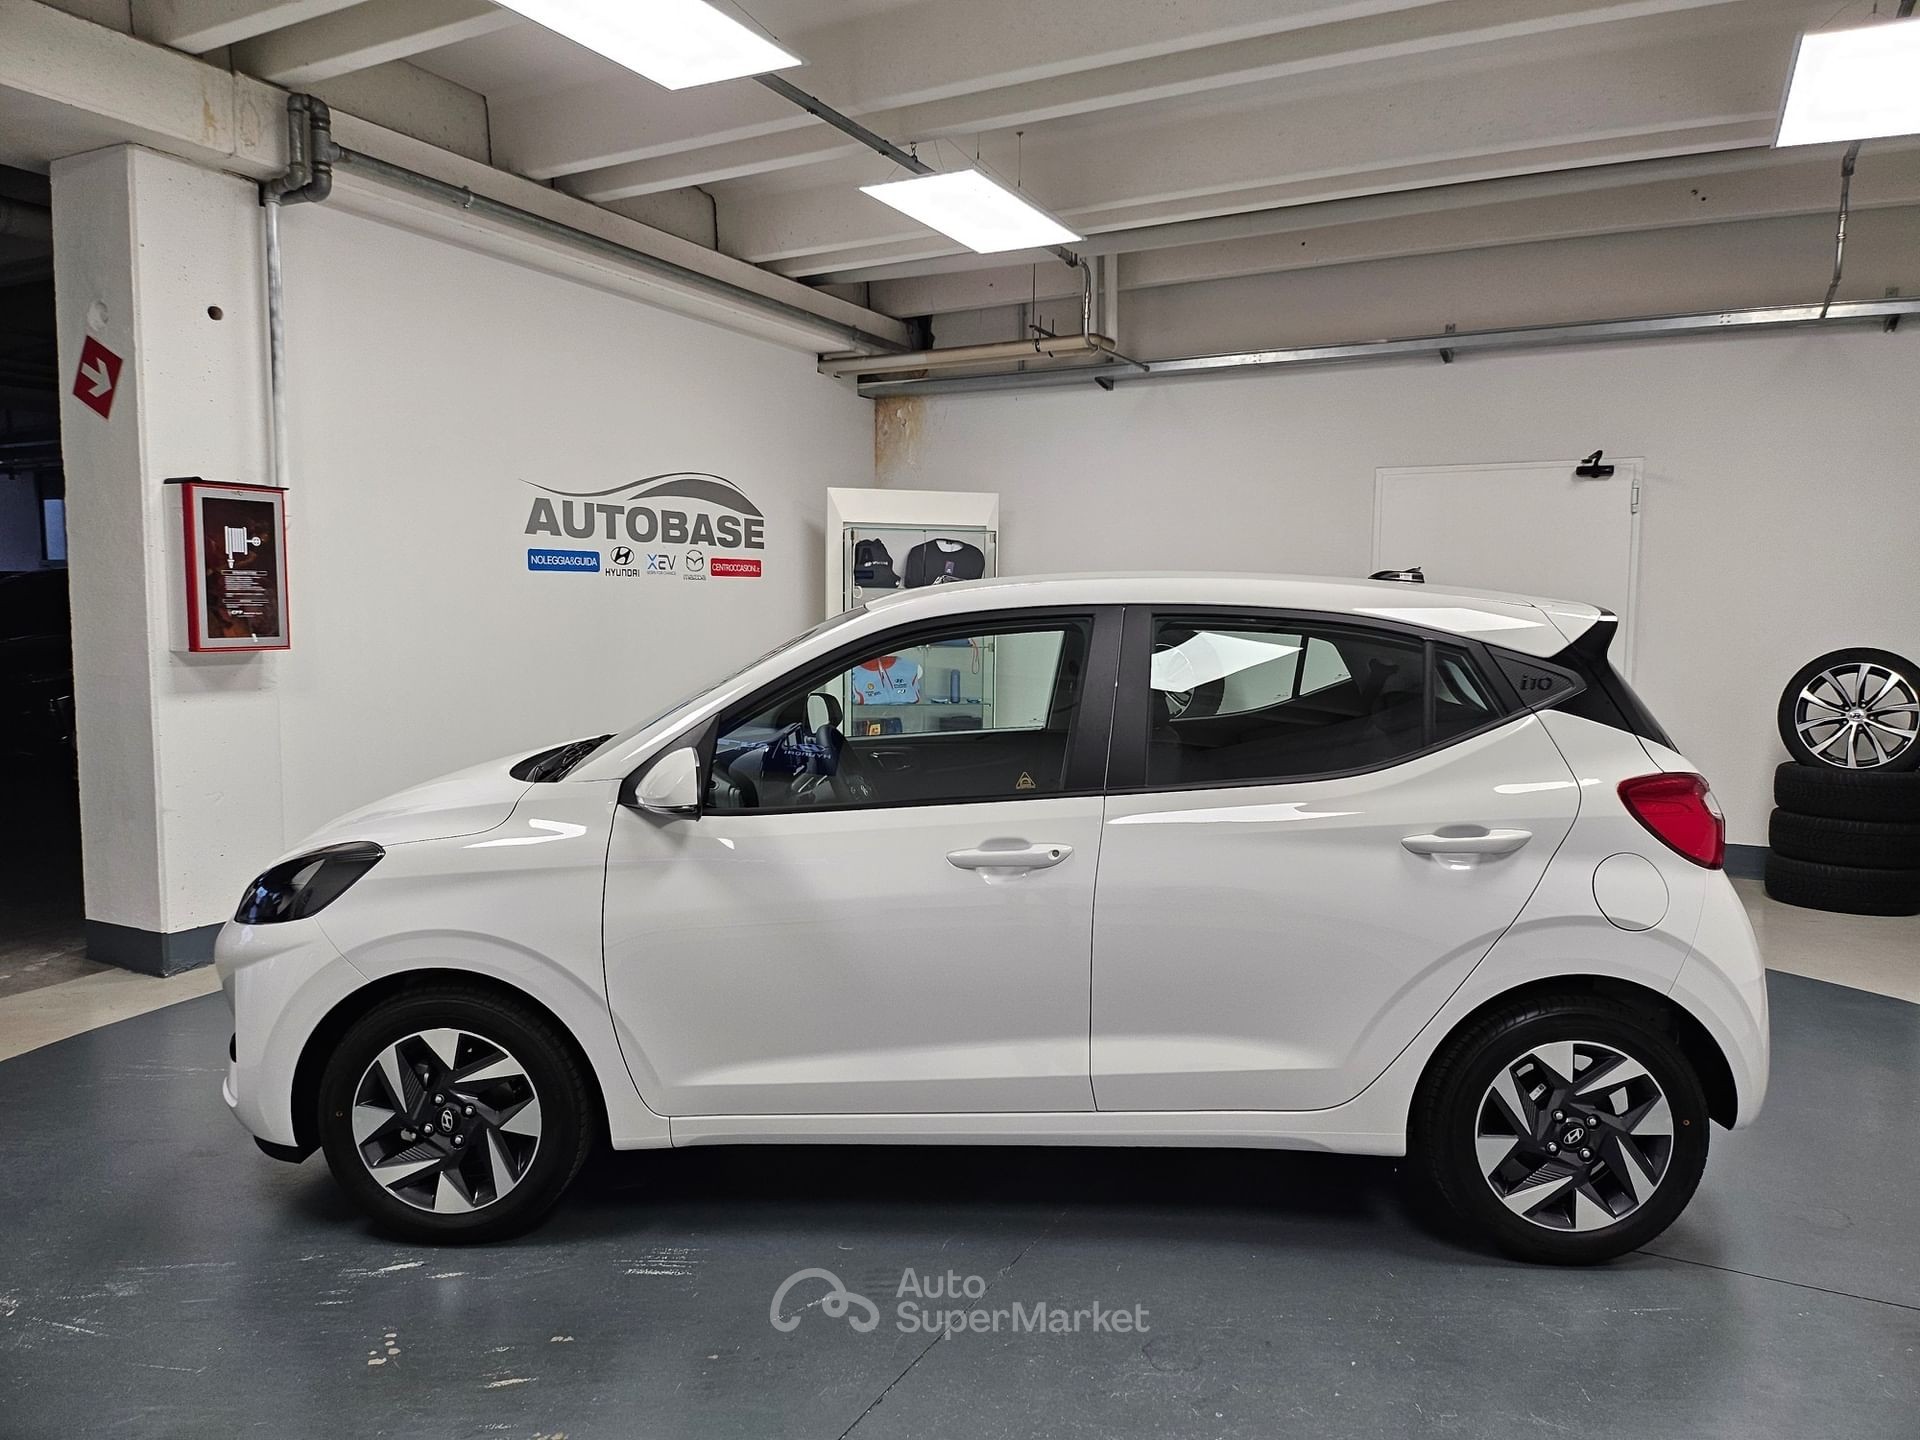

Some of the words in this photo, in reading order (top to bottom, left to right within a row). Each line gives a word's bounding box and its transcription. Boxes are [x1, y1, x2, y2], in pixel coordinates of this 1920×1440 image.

[524, 497, 765, 549] AUTOBASE
[530, 555, 598, 567] NOLEGGIA&GUIDA
[647, 554, 676, 570] XEV
[605, 568, 640, 577] HYUNDAI
